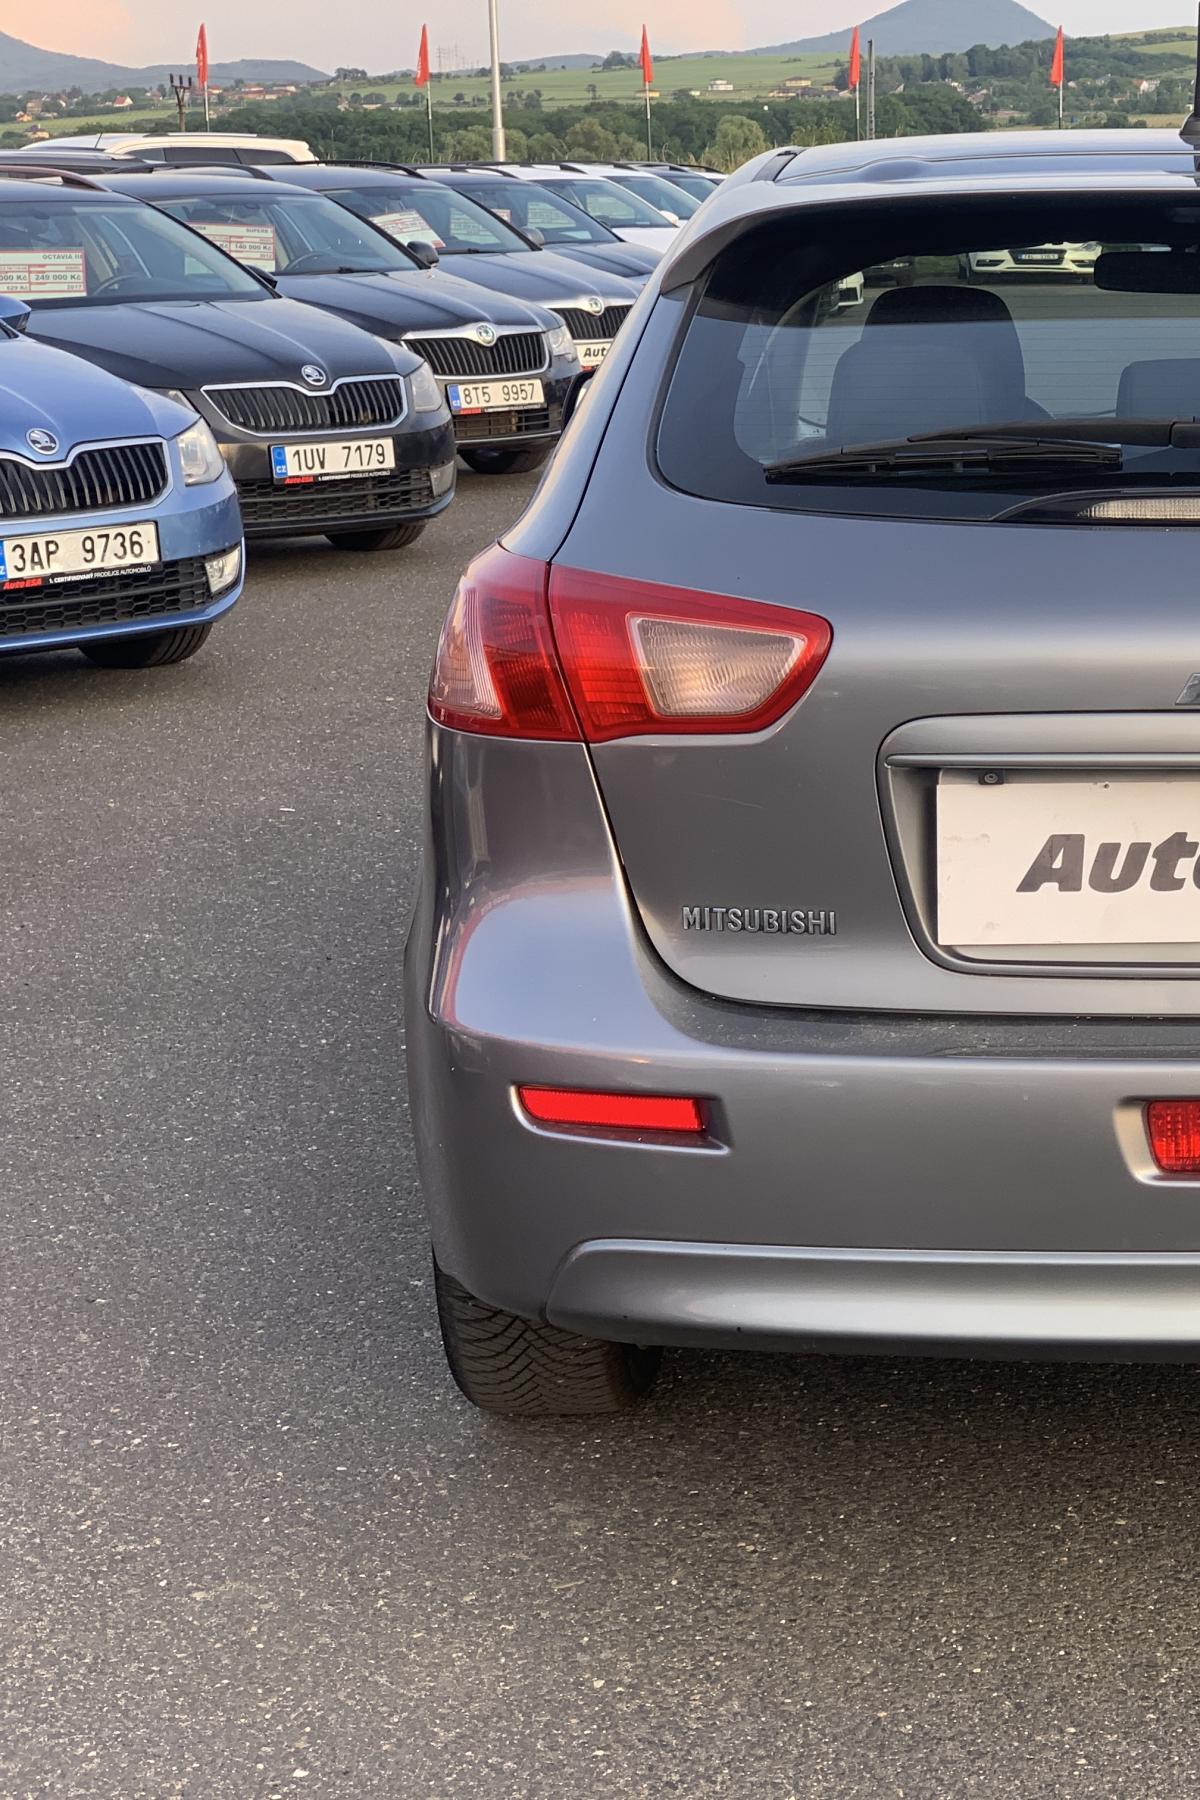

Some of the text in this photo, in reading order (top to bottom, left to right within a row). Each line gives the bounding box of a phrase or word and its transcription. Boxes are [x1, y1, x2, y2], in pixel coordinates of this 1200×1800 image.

[52, 273, 68, 281] 000
[70, 273, 81, 281] Kč
[583, 347, 606, 358] Aut
[463, 382, 535, 405] 8T5 9957
[292, 443, 386, 471] 1UV 7179
[276, 465, 287, 473] CZ
[11, 530, 144, 572] 3AP 9736
[682, 906, 837, 935] MITSUBISHI
